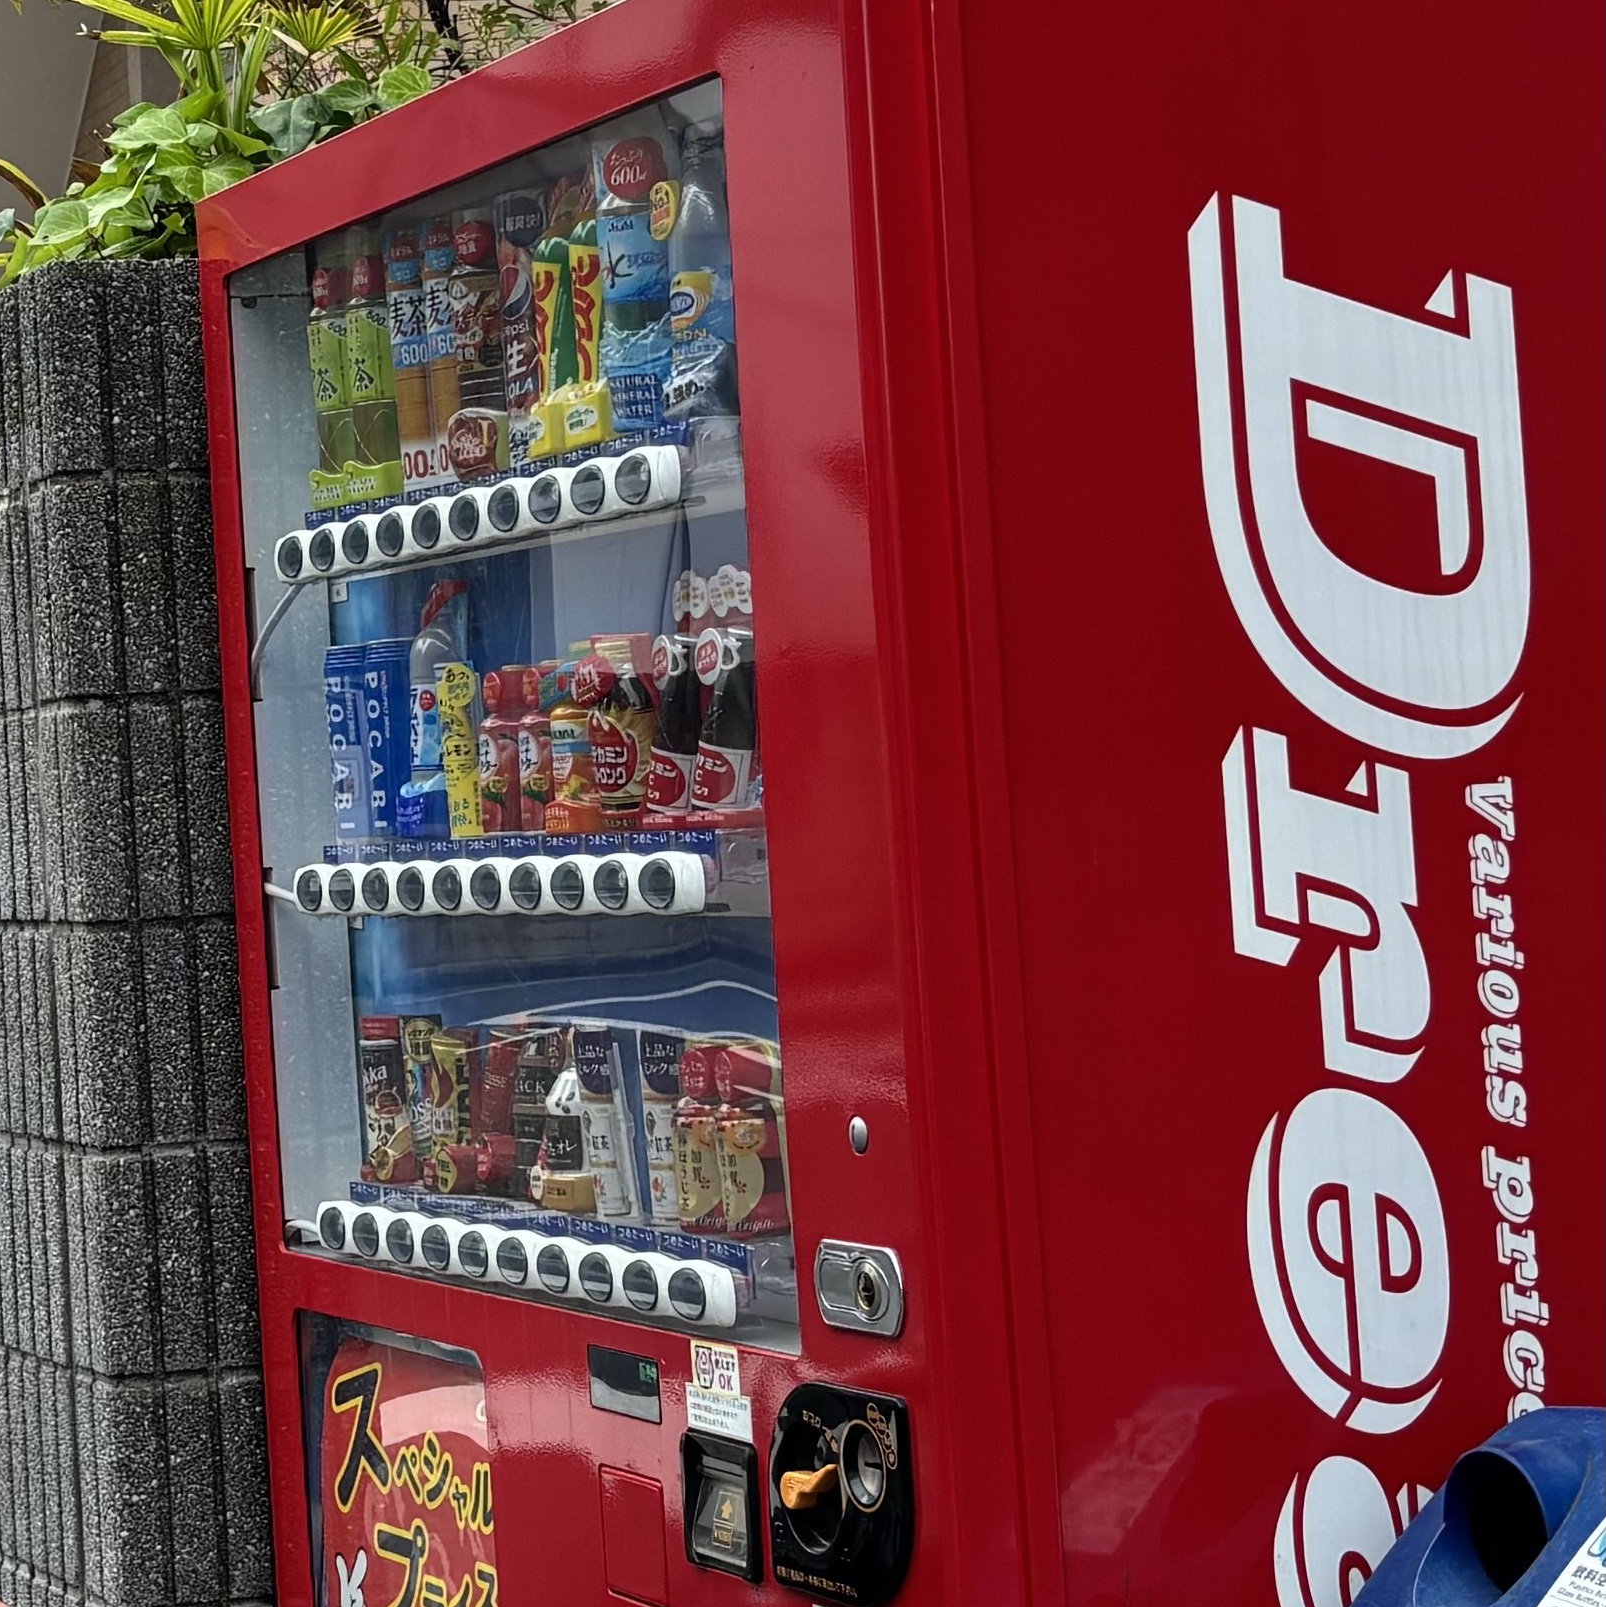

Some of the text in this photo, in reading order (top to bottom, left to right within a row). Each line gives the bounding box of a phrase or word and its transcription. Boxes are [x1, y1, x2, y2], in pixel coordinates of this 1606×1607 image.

[390, 295, 427, 340] 麦茶
[507, 377, 534, 399] OLA
[1465, 774, 1550, 1423] various pric
[718, 1373, 734, 1391] OK
[332, 1362, 495, 1535] スペシャル
